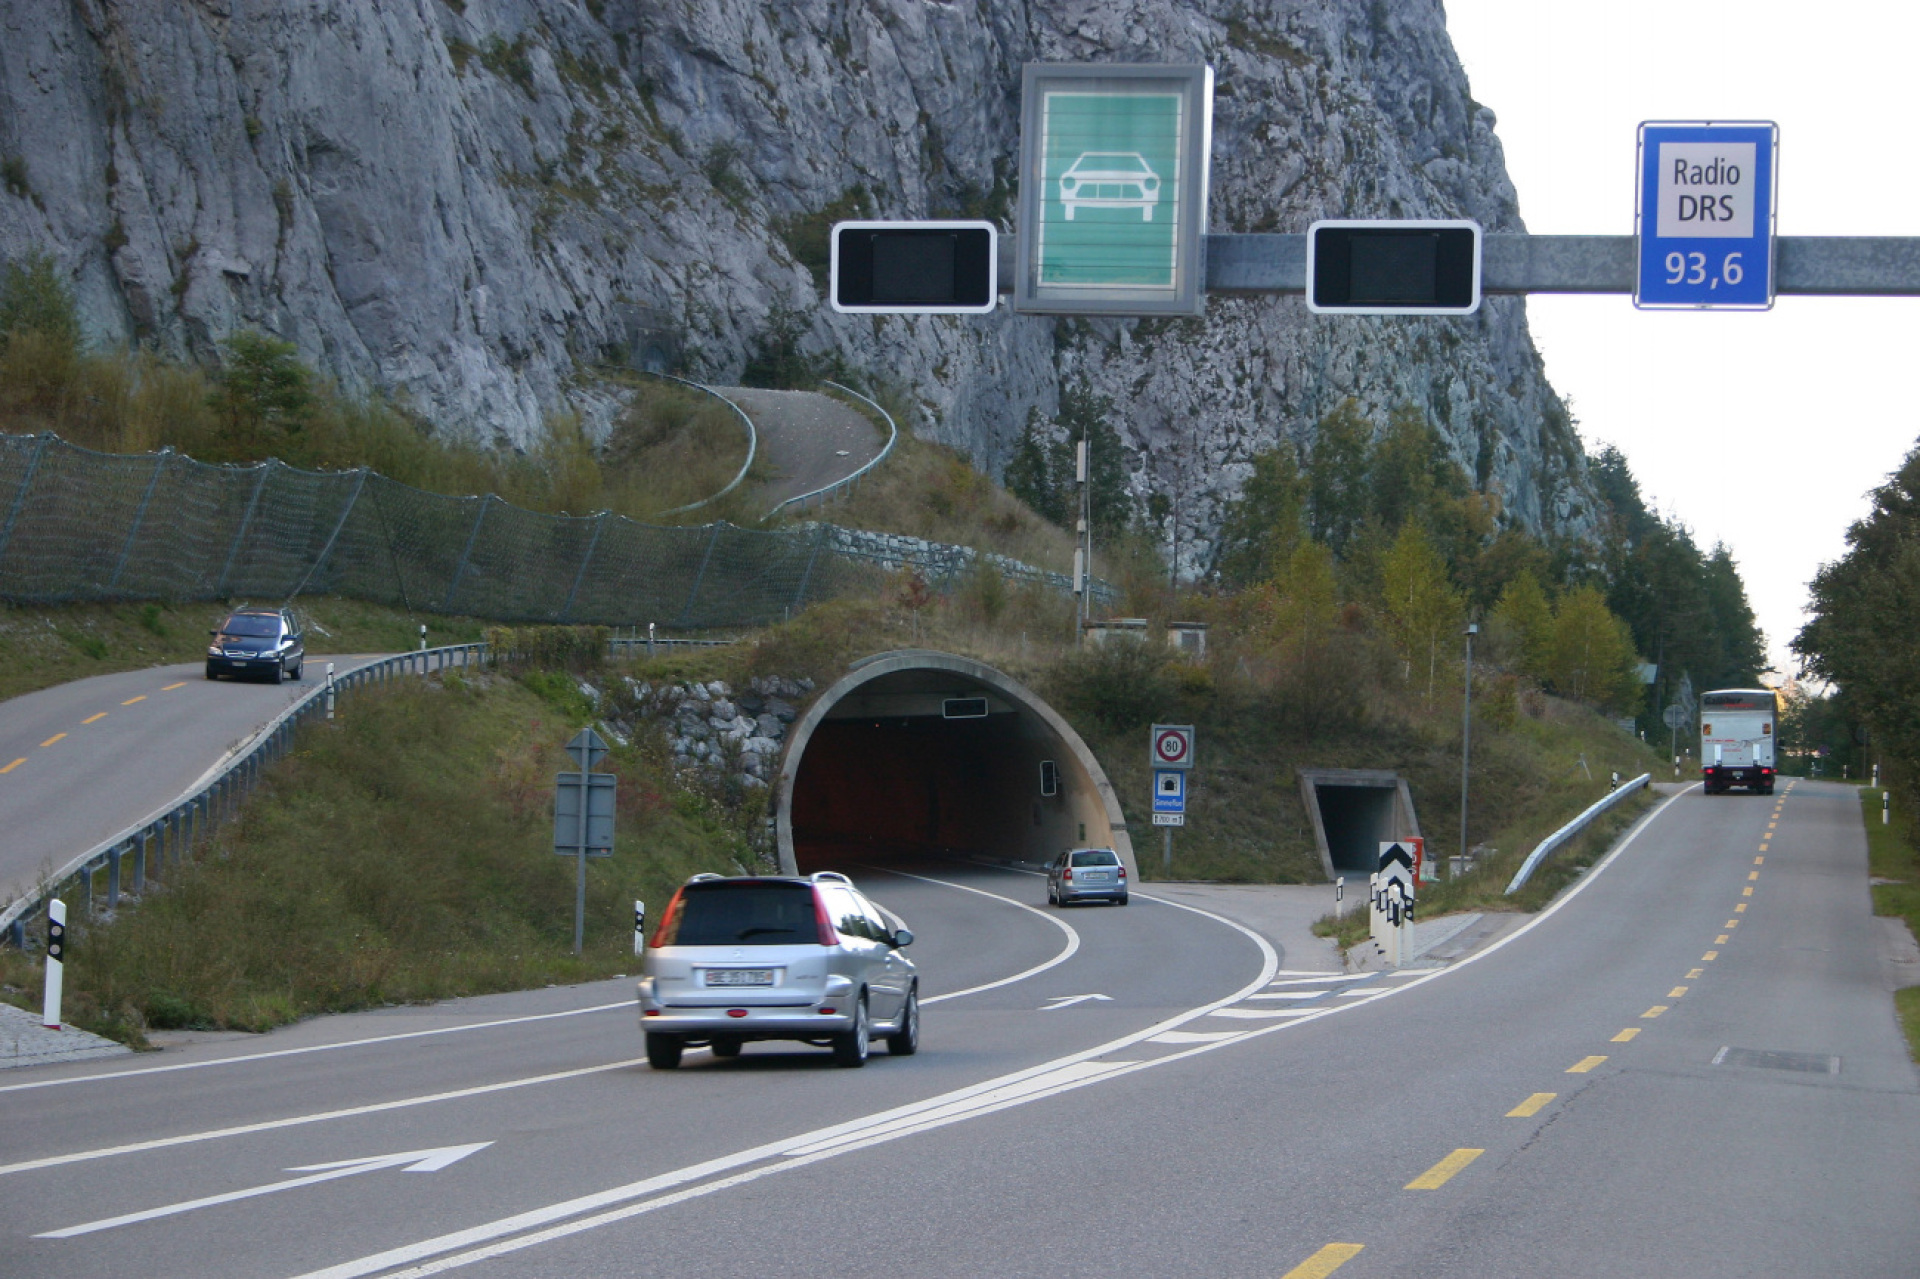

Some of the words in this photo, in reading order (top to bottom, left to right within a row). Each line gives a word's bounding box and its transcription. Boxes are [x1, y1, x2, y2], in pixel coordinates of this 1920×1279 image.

[1674, 157, 1740, 186] Radio
[1678, 195, 1734, 222] DRS
[1665, 252, 1743, 290] 93,6
[1166, 741, 1178, 752] 80
